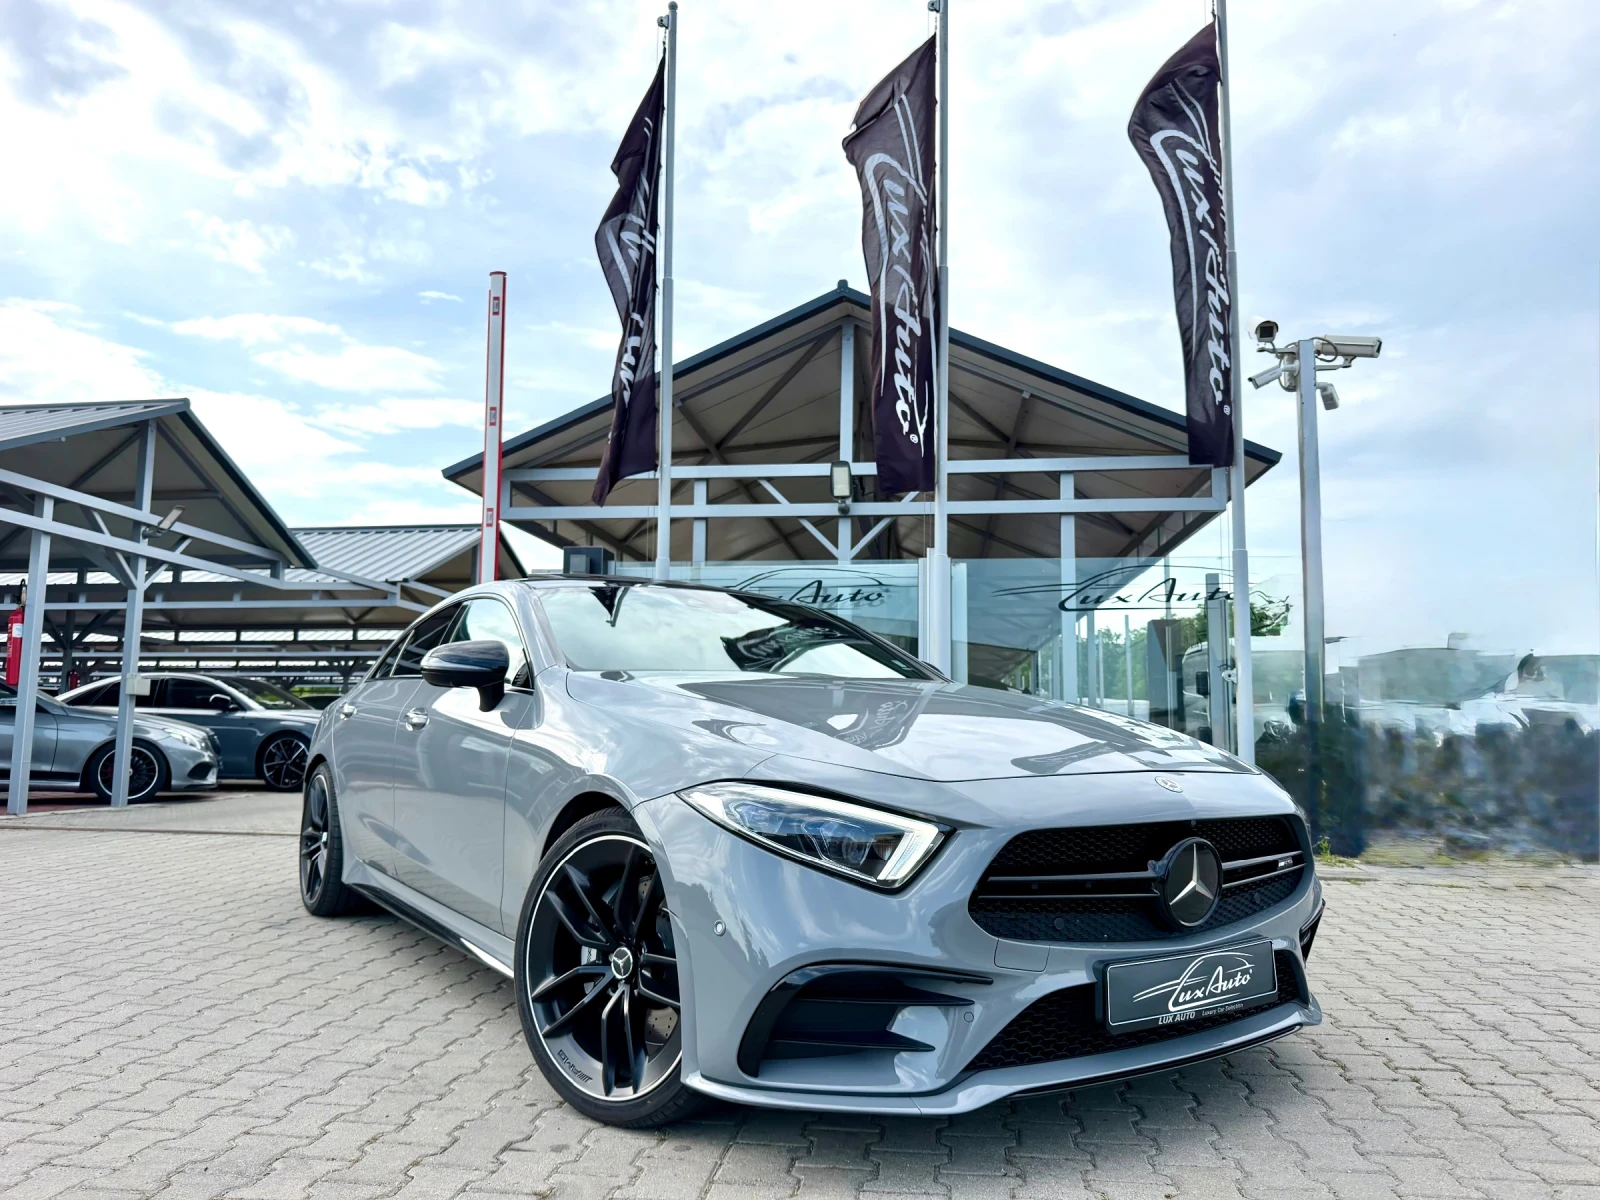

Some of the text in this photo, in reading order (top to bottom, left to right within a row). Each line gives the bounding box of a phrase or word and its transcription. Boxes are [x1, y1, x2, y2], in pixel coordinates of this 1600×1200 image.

[1168, 964, 1212, 1012] Lux
[1158, 1014, 1174, 1025] LUX
[1174, 1012, 1195, 1022] AUTO
